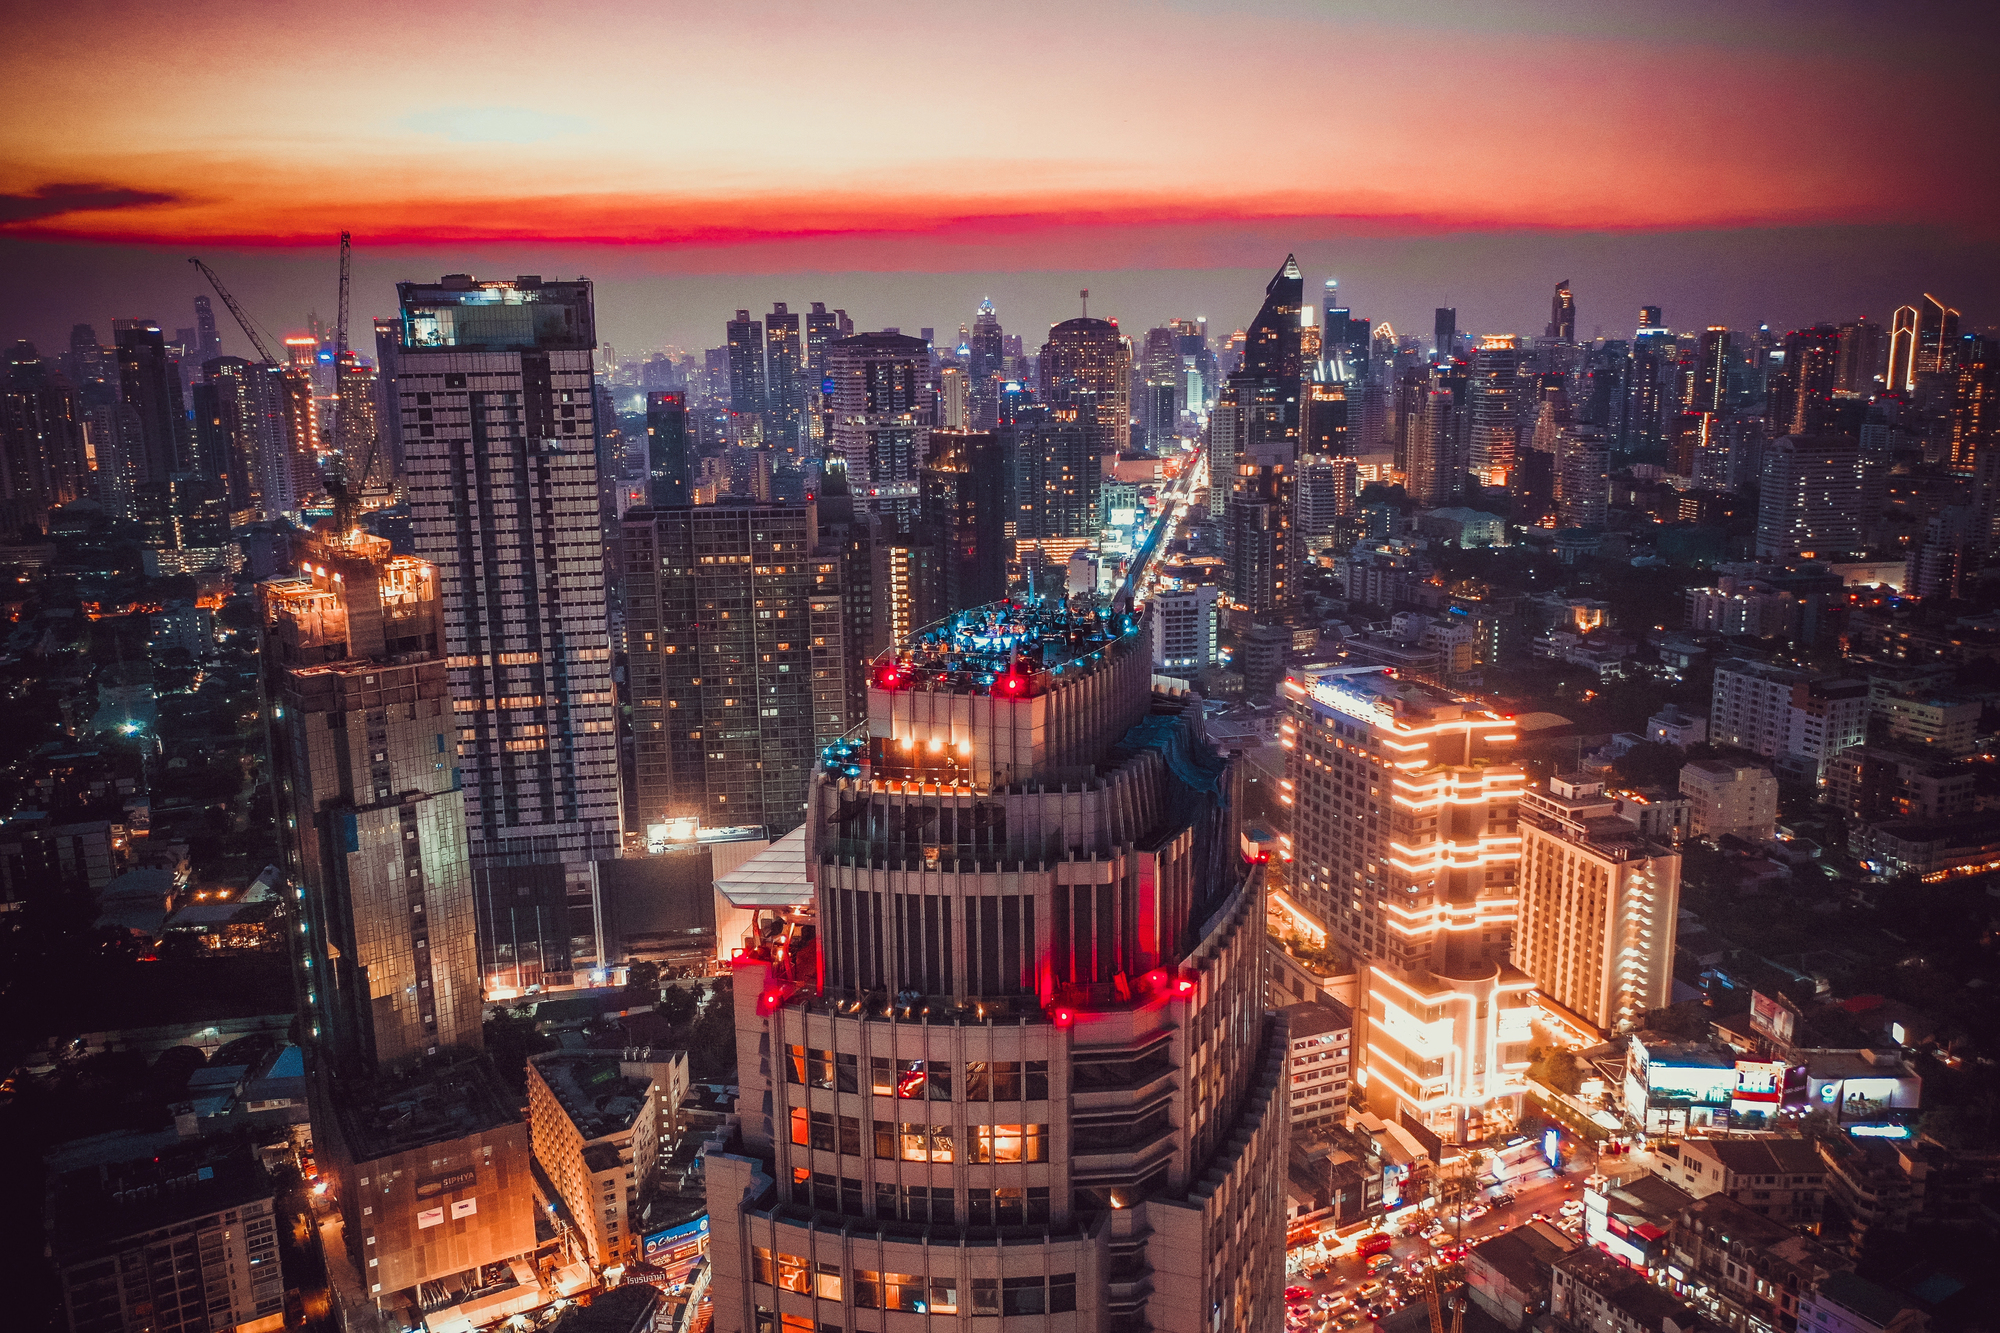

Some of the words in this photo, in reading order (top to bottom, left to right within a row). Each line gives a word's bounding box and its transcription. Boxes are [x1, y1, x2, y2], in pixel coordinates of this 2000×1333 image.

[443, 1172, 474, 1186] SIPHYA
[626, 1271, 666, 1285] โรงรับจำนำ
